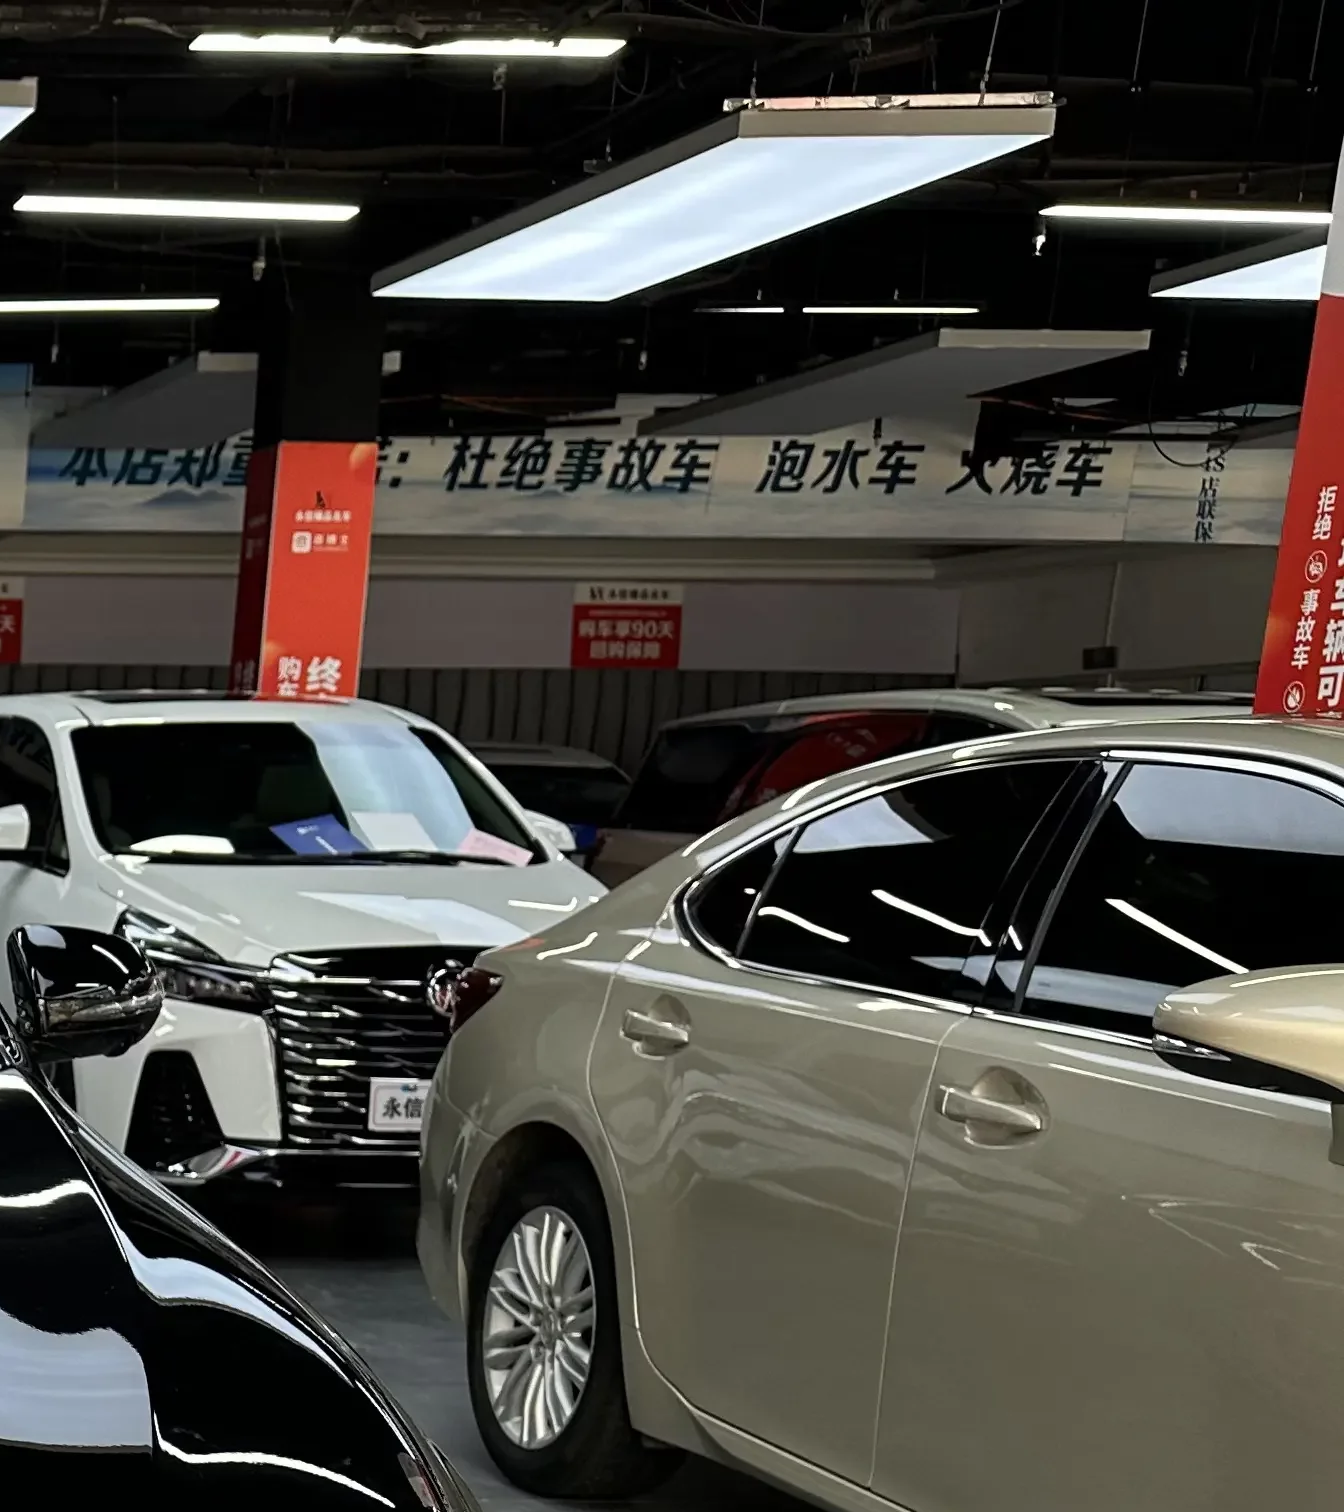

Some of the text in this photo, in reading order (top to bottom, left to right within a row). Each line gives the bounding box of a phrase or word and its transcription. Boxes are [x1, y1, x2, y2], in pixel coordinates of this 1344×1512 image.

[444, 436, 720, 492] 杜绝事故车
[754, 439, 925, 495] 泡水车
[1291, 485, 1338, 670] 拒绝 事故车
